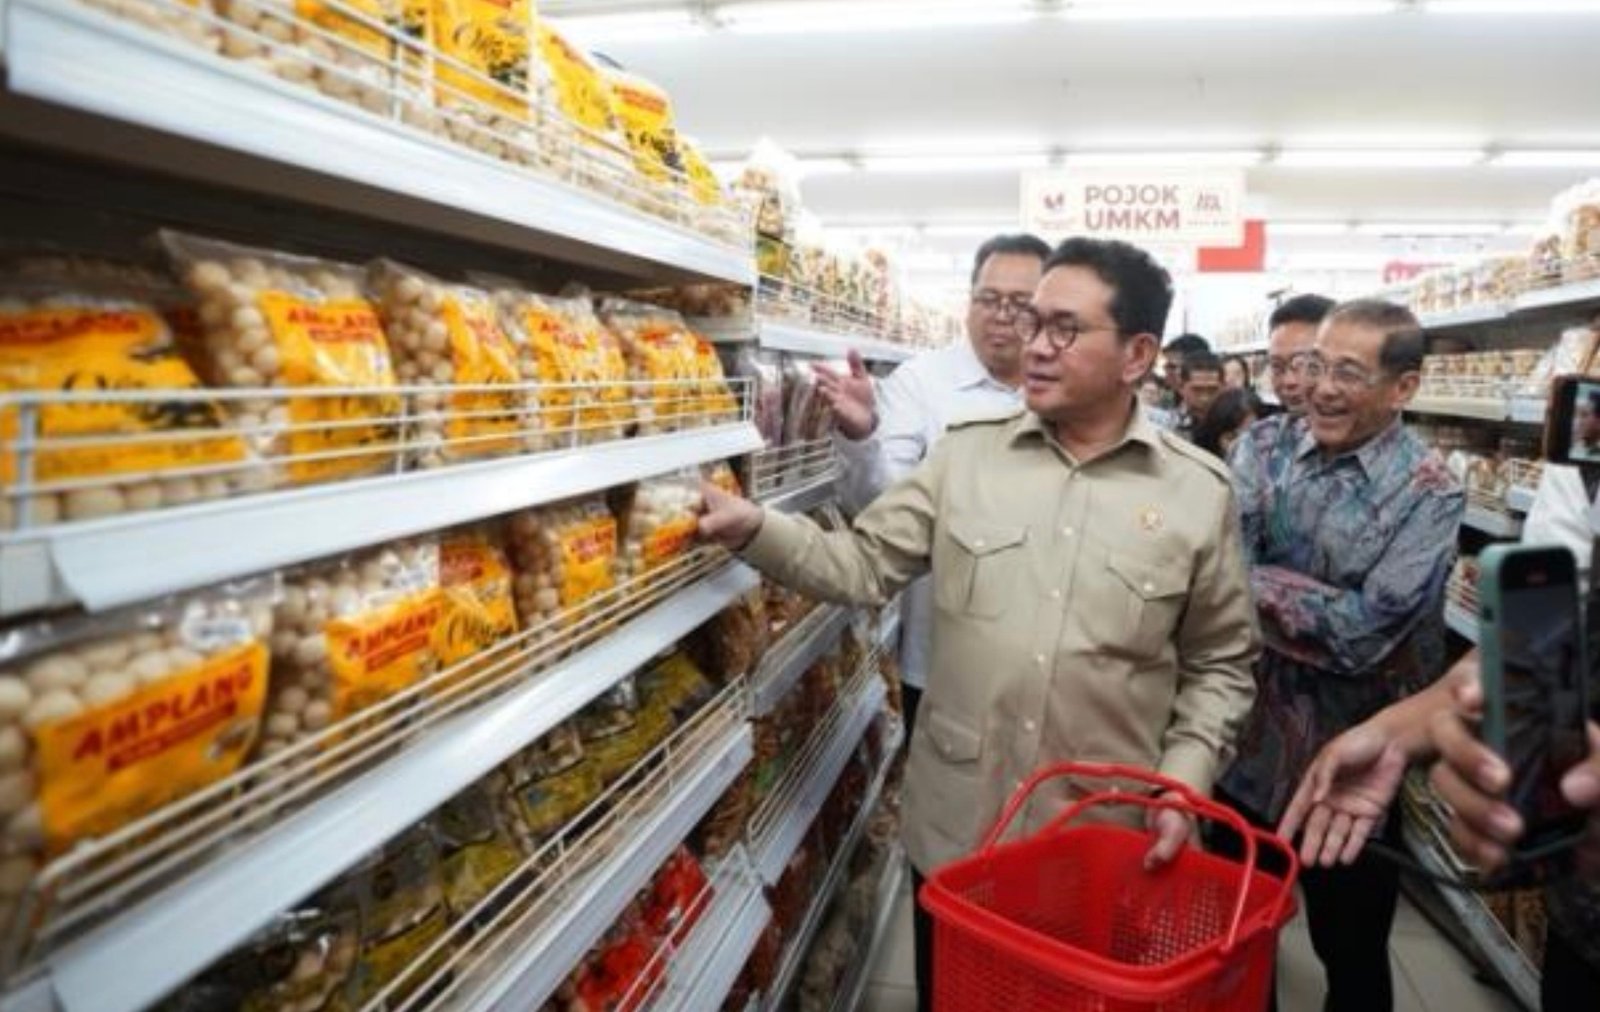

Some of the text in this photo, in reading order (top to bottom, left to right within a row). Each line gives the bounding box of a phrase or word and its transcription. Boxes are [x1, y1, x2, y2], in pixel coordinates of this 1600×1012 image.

[1085, 184, 1181, 205] POJOK
[1085, 209, 1181, 231] UMKM
[72, 663, 253, 764] AMPLANG
